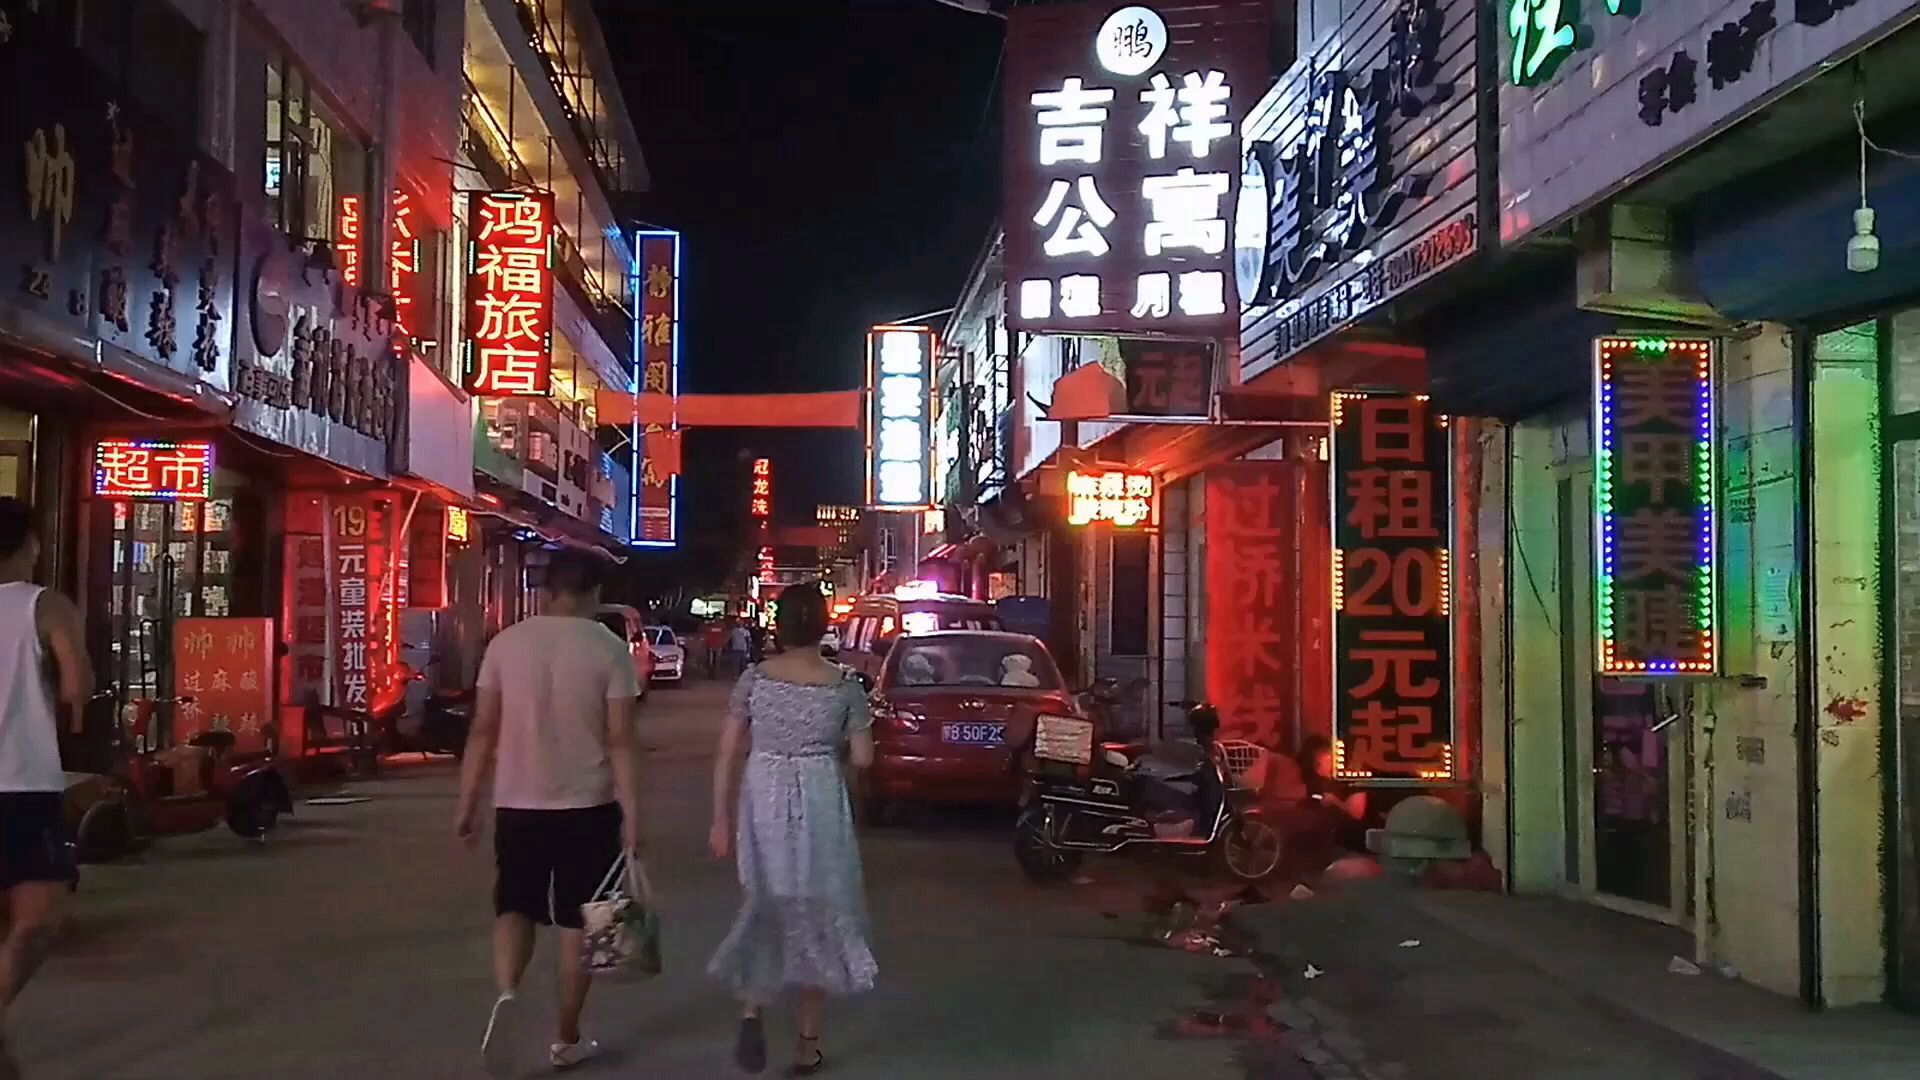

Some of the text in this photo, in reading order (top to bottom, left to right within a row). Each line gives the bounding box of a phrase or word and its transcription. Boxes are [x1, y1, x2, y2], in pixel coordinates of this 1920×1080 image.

[1113, 18, 1153, 58] 鹏
[1030, 69, 1233, 167] 吉祥
[1031, 167, 1231, 258] 公寓
[472, 196, 546, 392] 鸿福旅店
[102, 447, 206, 491] 超市
[1346, 400, 1441, 773] 日租20元起
